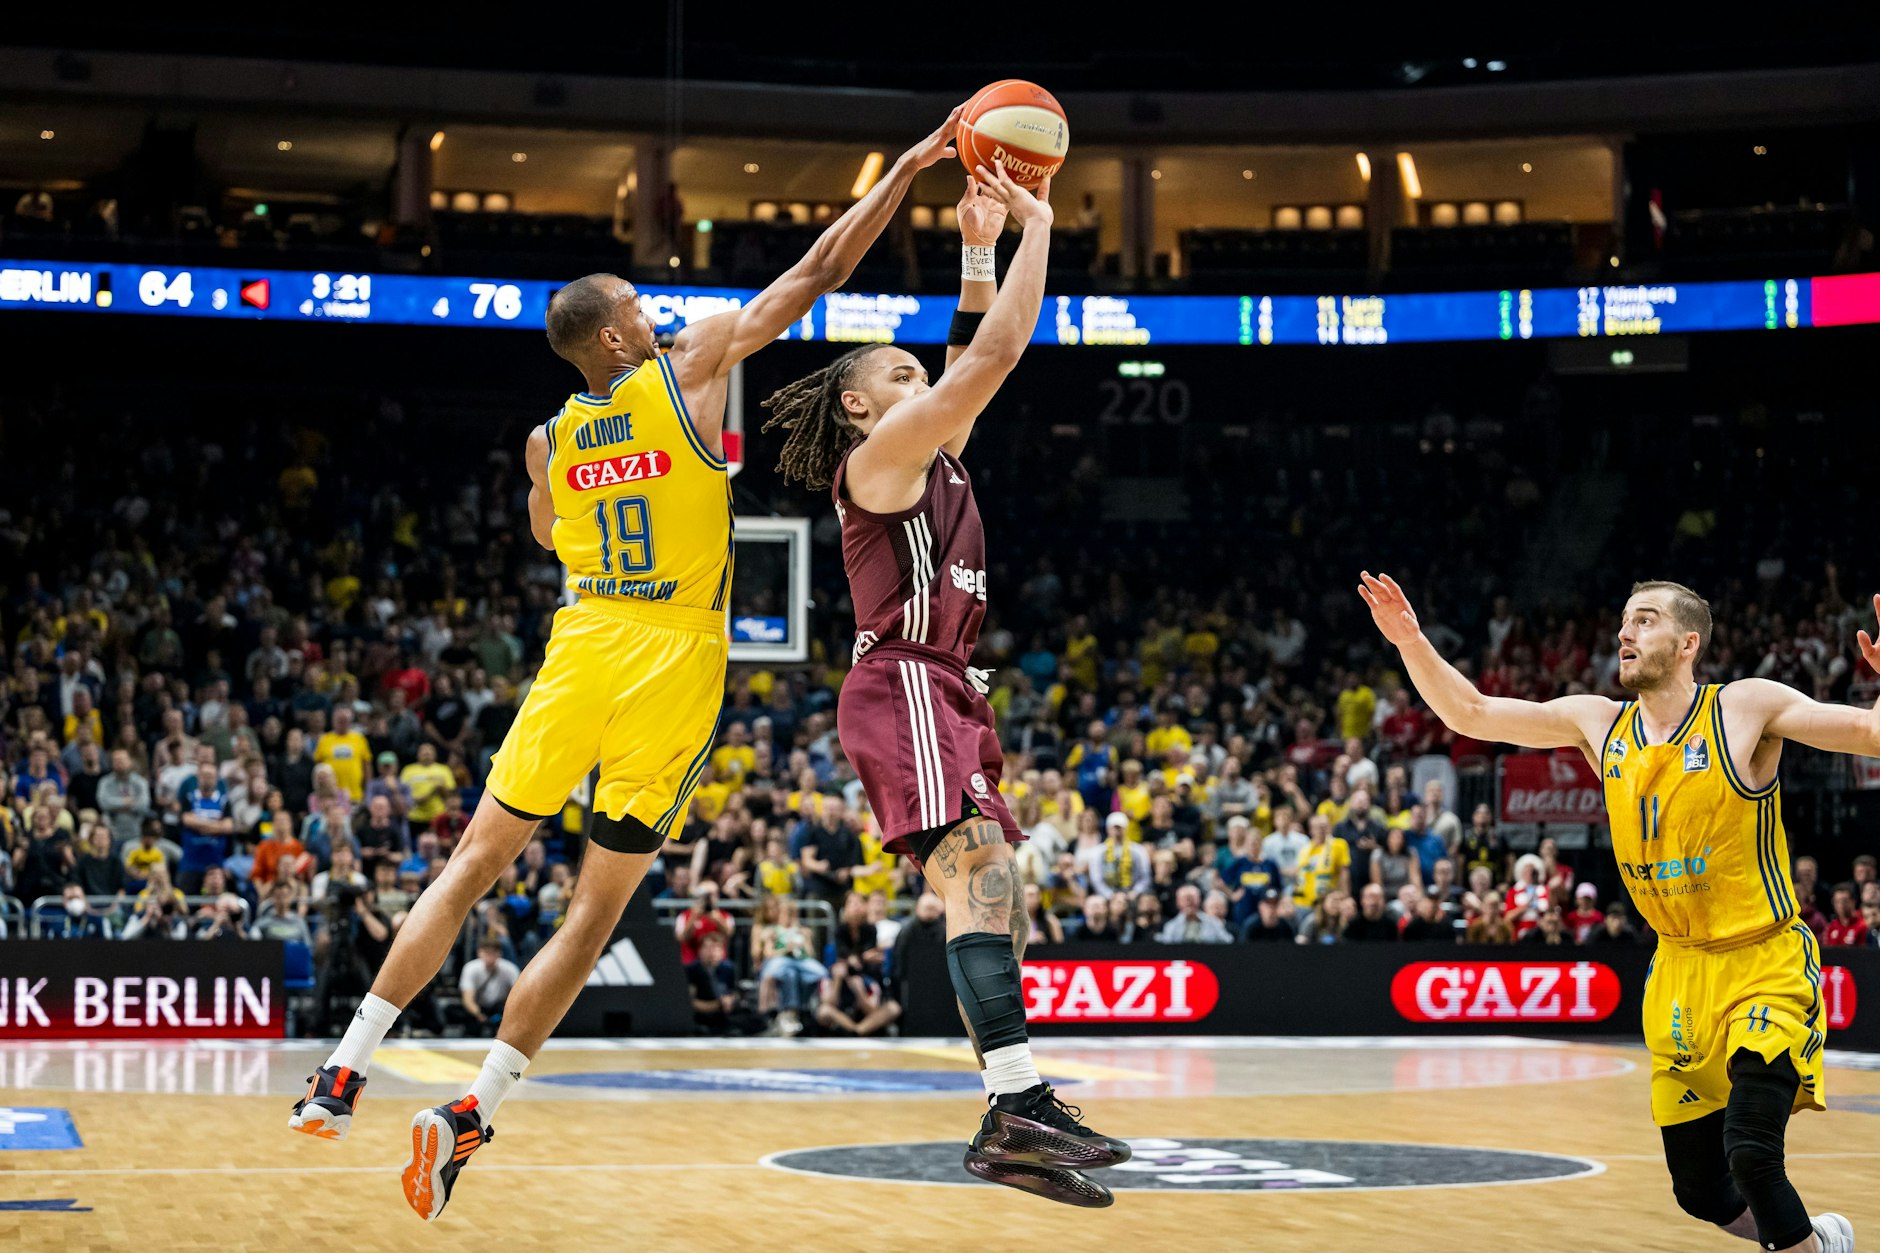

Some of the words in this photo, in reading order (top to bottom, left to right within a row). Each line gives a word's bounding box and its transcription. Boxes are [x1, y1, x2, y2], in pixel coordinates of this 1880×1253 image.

[989, 144, 1061, 178] SPALDING
[0, 269, 92, 304] ERLIN
[138, 270, 194, 307] 64
[469, 283, 523, 320] 76
[1098, 380, 1190, 424] 220
[594, 494, 656, 576] 19
[1639, 795, 1660, 842] 11
[74, 976, 270, 1027] BERLIN
[1747, 1003, 1770, 1033] 11
